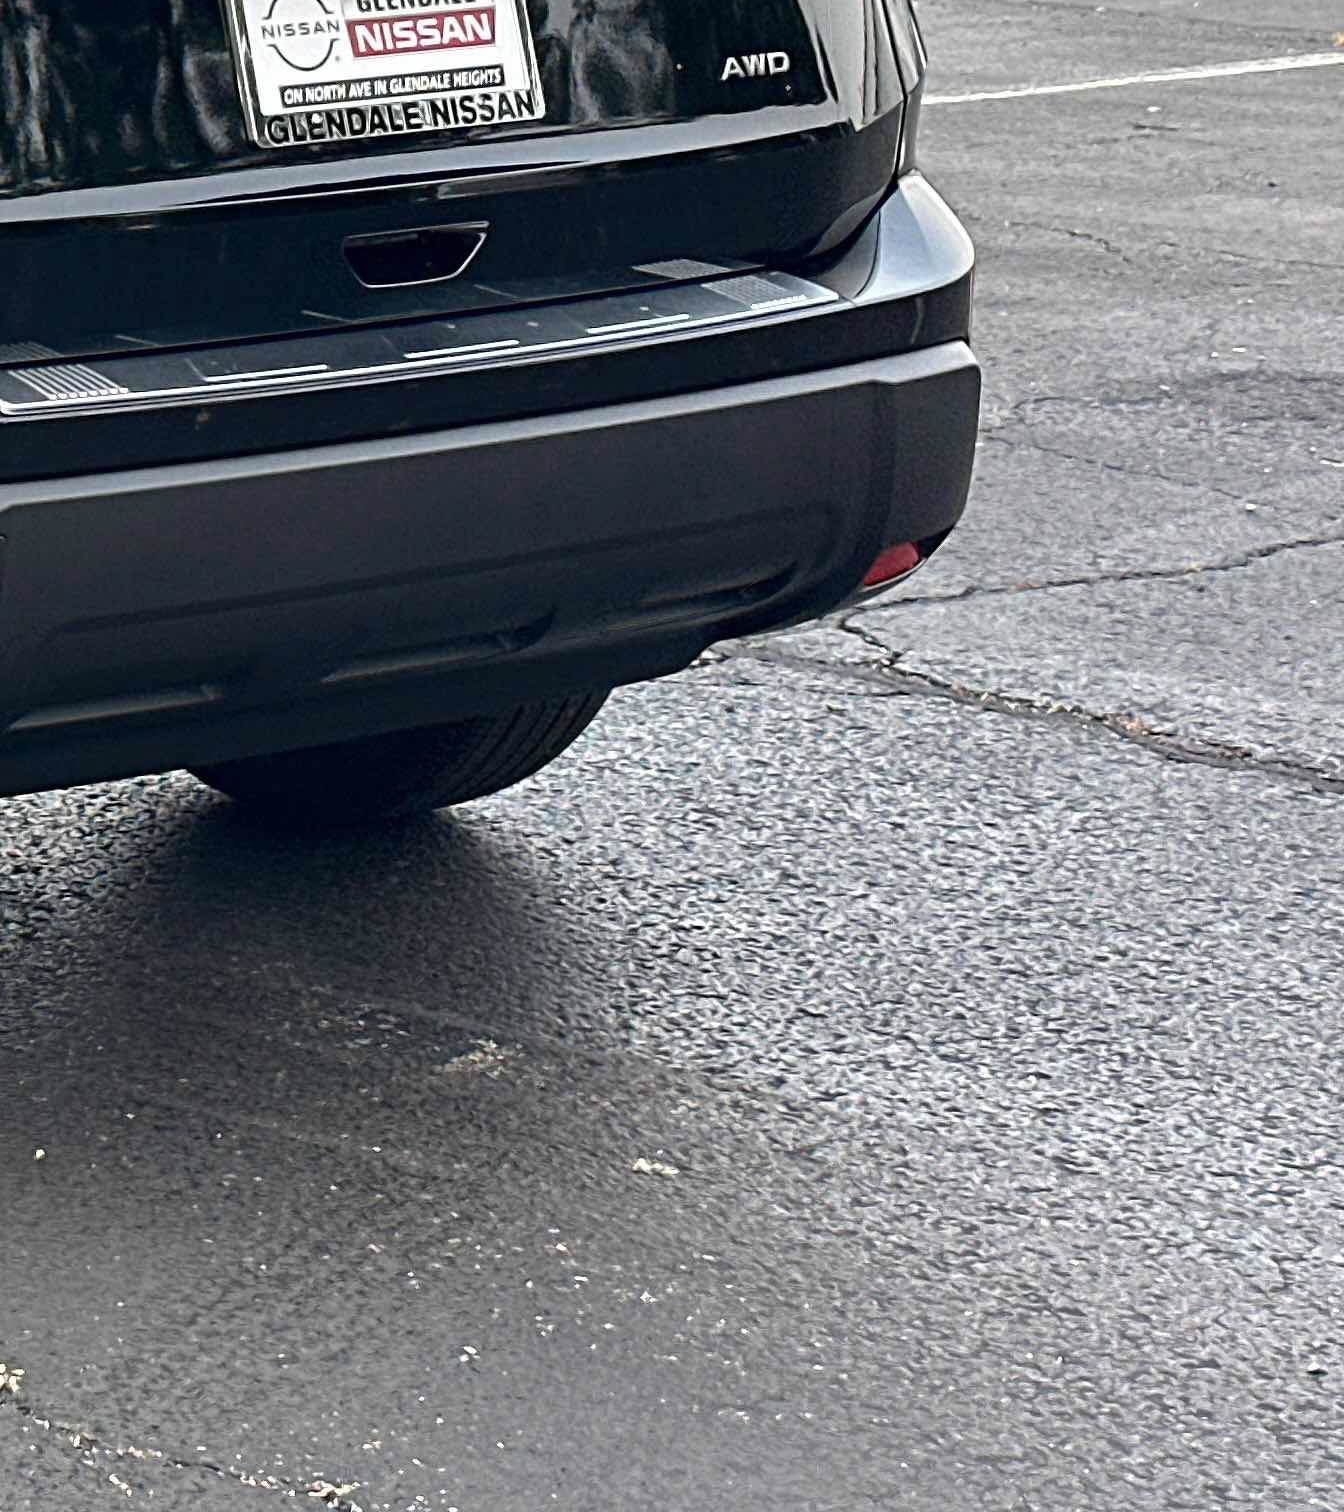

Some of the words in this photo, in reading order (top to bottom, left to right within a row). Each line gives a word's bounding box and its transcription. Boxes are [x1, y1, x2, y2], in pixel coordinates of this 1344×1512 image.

[261, 19, 341, 40] NISSAN
[354, 13, 493, 54] NISSAN
[720, 51, 791, 81] AWD
[283, 89, 303, 105] ON
[305, 83, 345, 103] NORTH
[348, 80, 372, 99] AVE
[374, 79, 388, 96] IN
[389, 73, 451, 94] GLENDALE
[453, 68, 502, 88] HEIGHTS
[267, 100, 425, 144] GLENDALE
[430, 89, 537, 127] NISSAN
